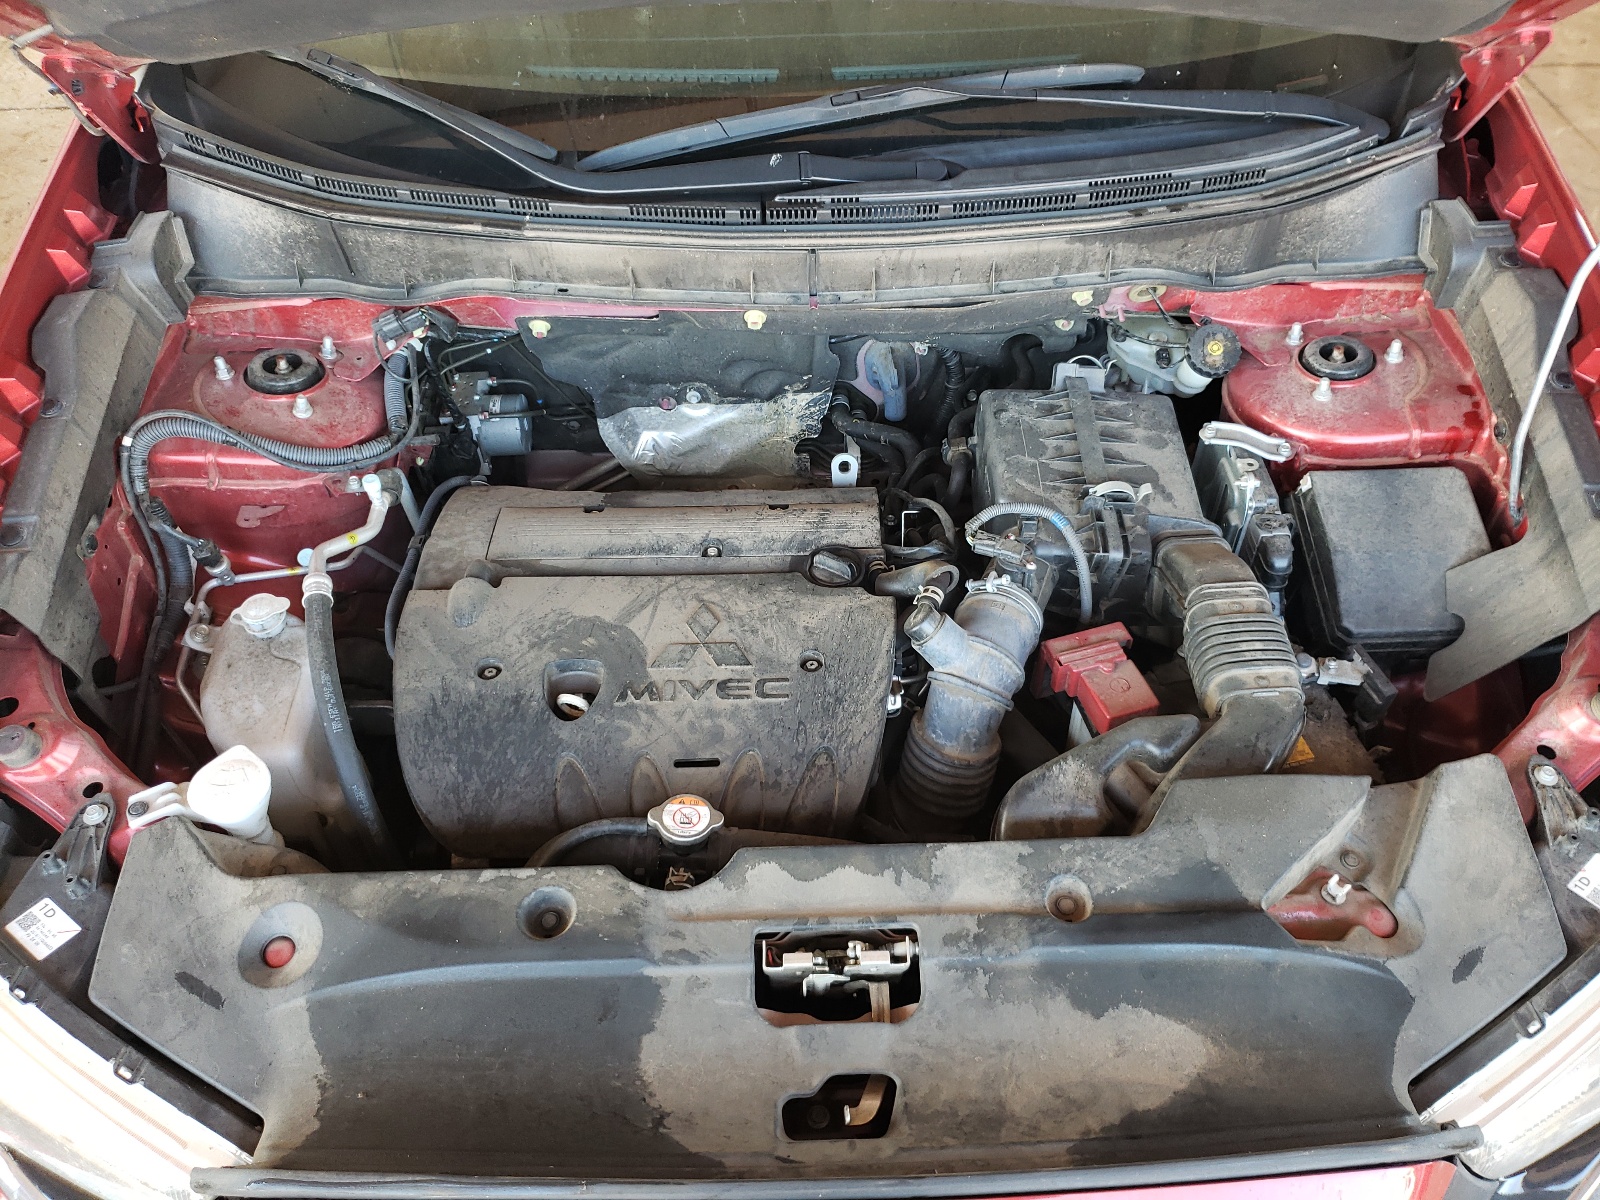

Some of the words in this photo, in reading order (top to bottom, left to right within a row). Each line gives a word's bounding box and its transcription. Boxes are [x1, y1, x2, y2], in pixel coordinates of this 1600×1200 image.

[614, 677, 790, 704] MIVEC
[1574, 876, 1591, 891] 1D
[39, 903, 56, 918] 1D
